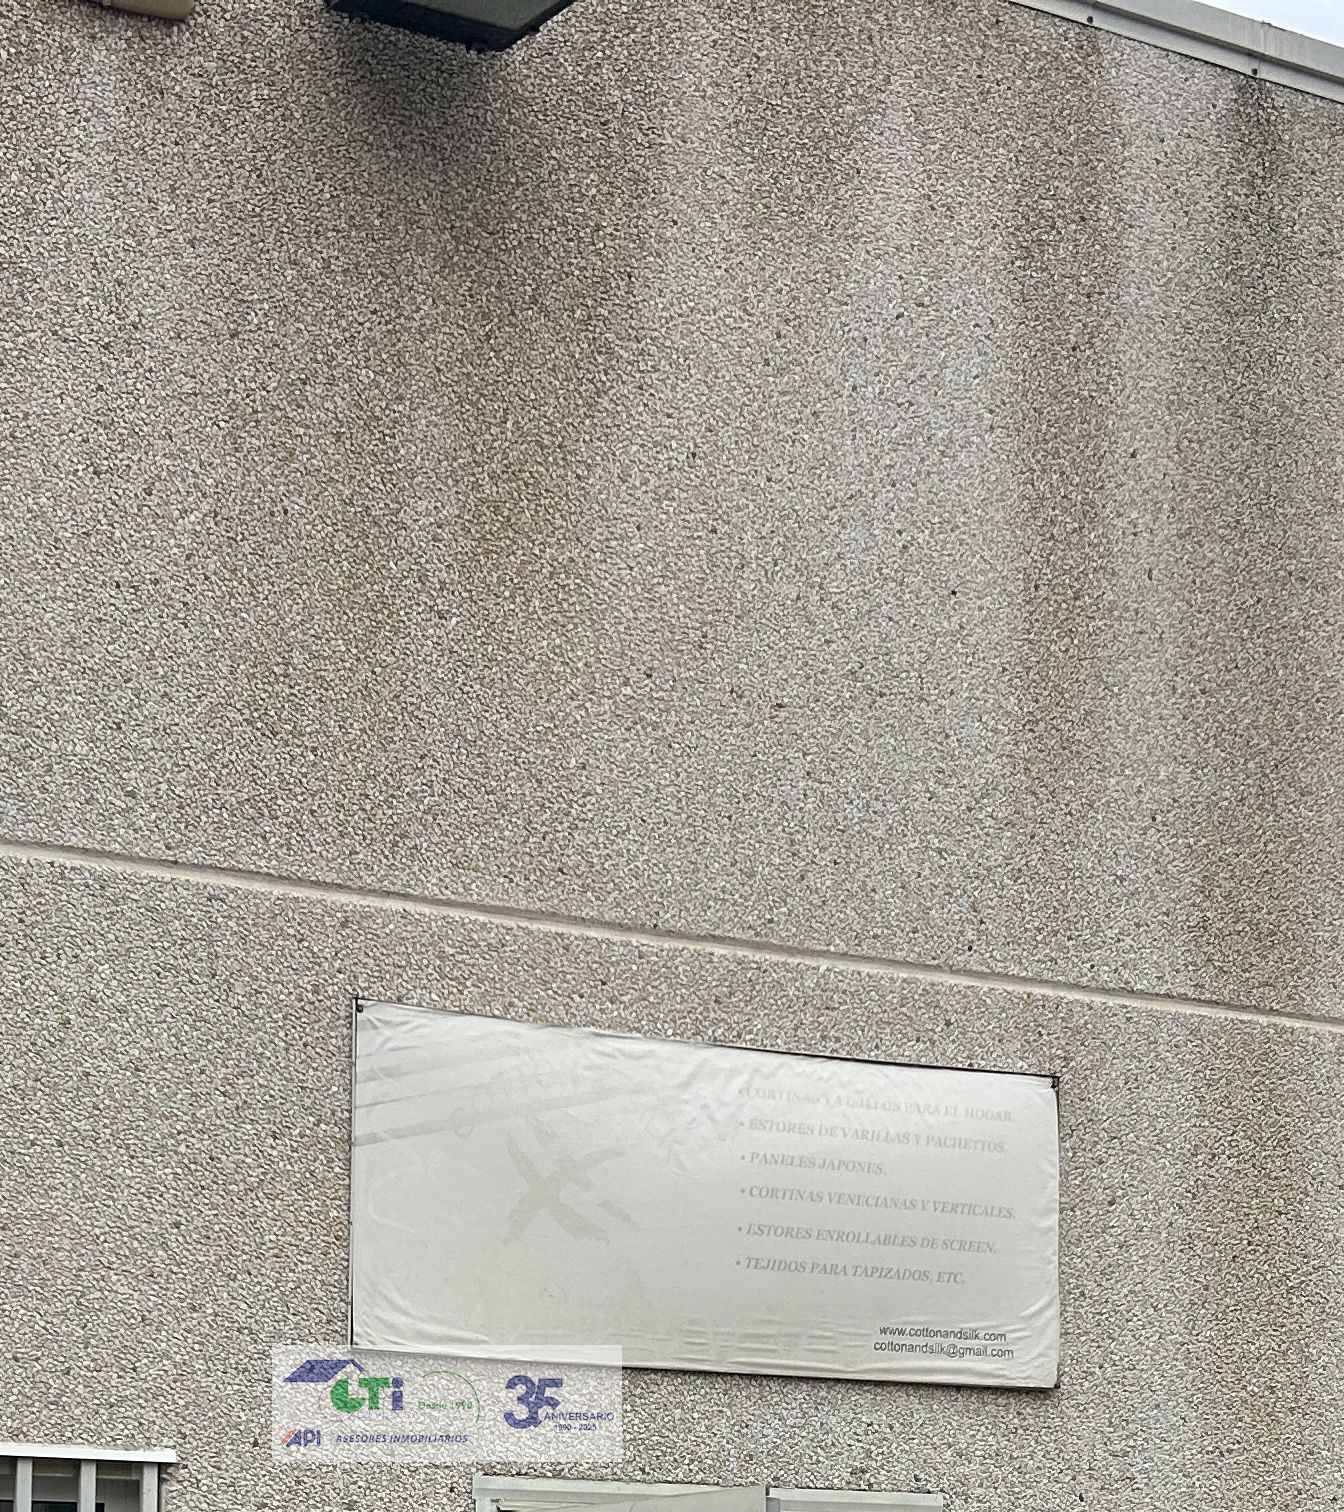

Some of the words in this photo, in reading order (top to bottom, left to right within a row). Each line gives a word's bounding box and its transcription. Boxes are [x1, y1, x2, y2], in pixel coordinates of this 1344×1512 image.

[904, 1102, 941, 1117] PARA
[944, 1105, 960, 1119] EL
[749, 1117, 815, 1136] ESTORES
[818, 1122, 839, 1138] DE
[840, 1125, 910, 1145] VARILLAS
[913, 1133, 923, 1147] Y
[749, 1151, 816, 1169] PANELES
[817, 1156, 887, 1175] JAPONES.
[749, 1185, 823, 1203] CORTINAS
[827, 1191, 917, 1211] VENECIANAS
[920, 1199, 930, 1212] Y
[932, 1201, 1016, 1219] VERTICALES.
[746, 1223, 813, 1241] ESTORES
[815, 1228, 917, 1249] ENROLLABLES
[920, 1237, 939, 1250] DE
[941, 1239, 998, 1255] SCREEN.
[745, 1256, 808, 1274] TEJIDOS
[809, 1261, 848, 1277] PARA
[851, 1264, 934, 1284] TAPIZADOS,
[936, 1271, 966, 1285] ETC.
[879, 1324, 1007, 1343] www.cottonandsilk.com
[873, 1340, 1015, 1359] cottonandsilk@gmail.com
